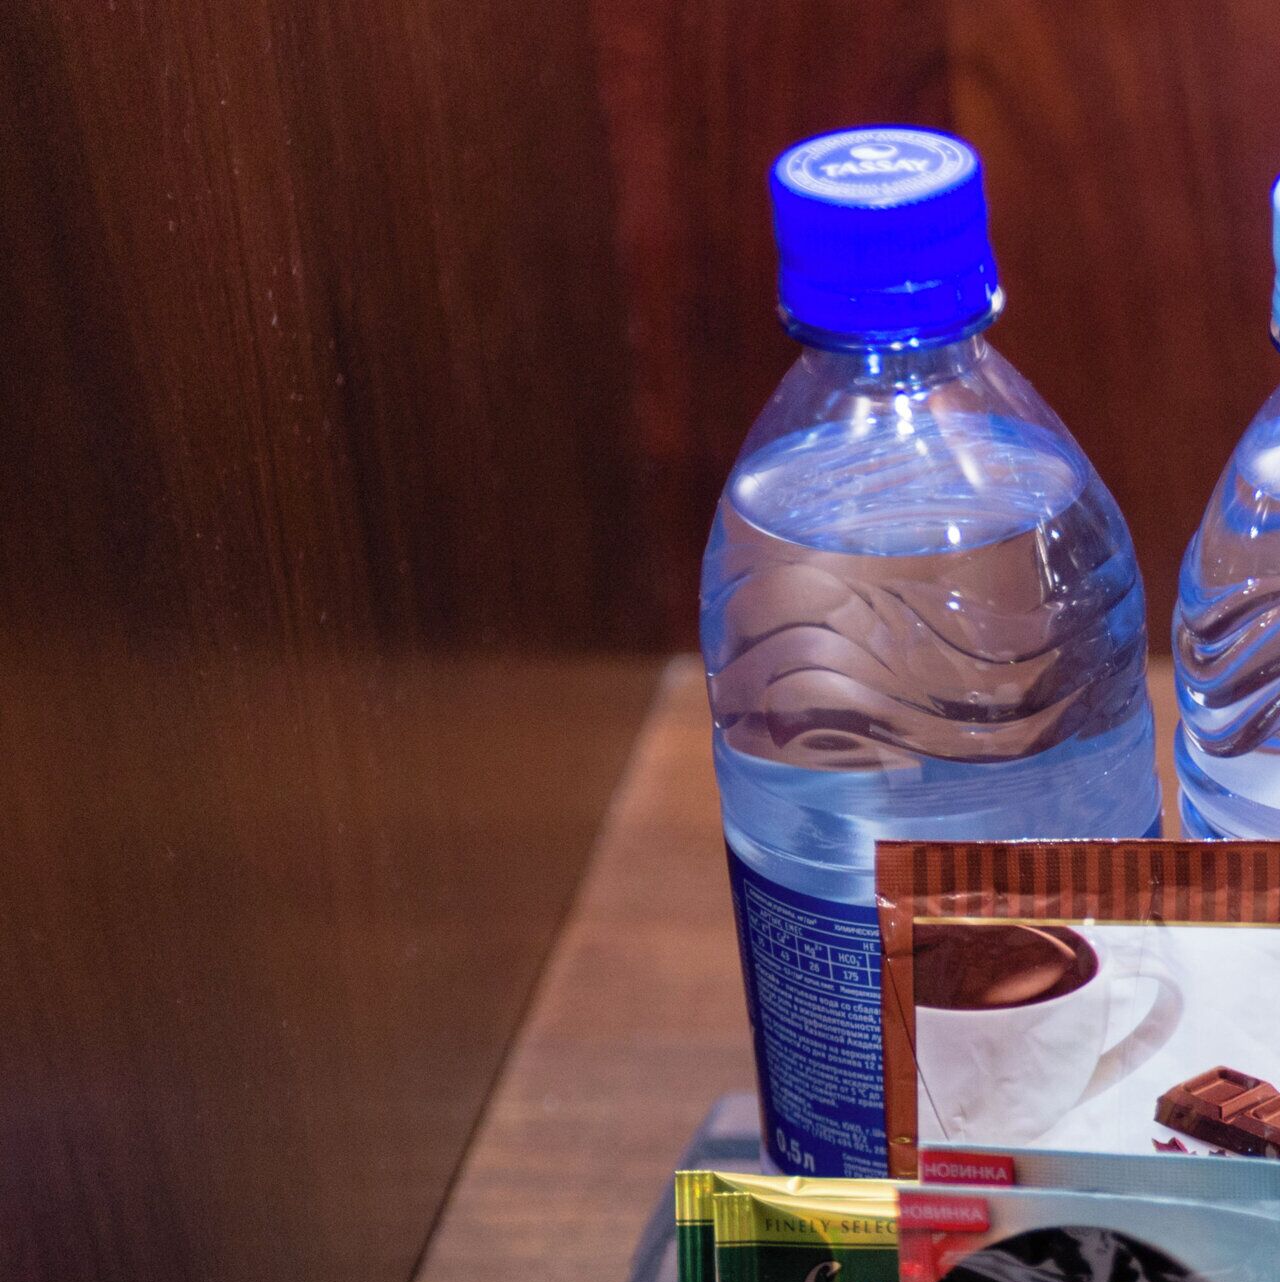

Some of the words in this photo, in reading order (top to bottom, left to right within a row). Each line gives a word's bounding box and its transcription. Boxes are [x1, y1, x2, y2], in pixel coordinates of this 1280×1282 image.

[820, 158, 931, 177] TASSAY
[862, 942, 875, 952] НЕ
[843, 970, 860, 981] 175
[924, 1163, 1008, 1182] НОВИНКА
[901, 1204, 985, 1222] НОВИНКА
[764, 1217, 830, 1234] FINELY
